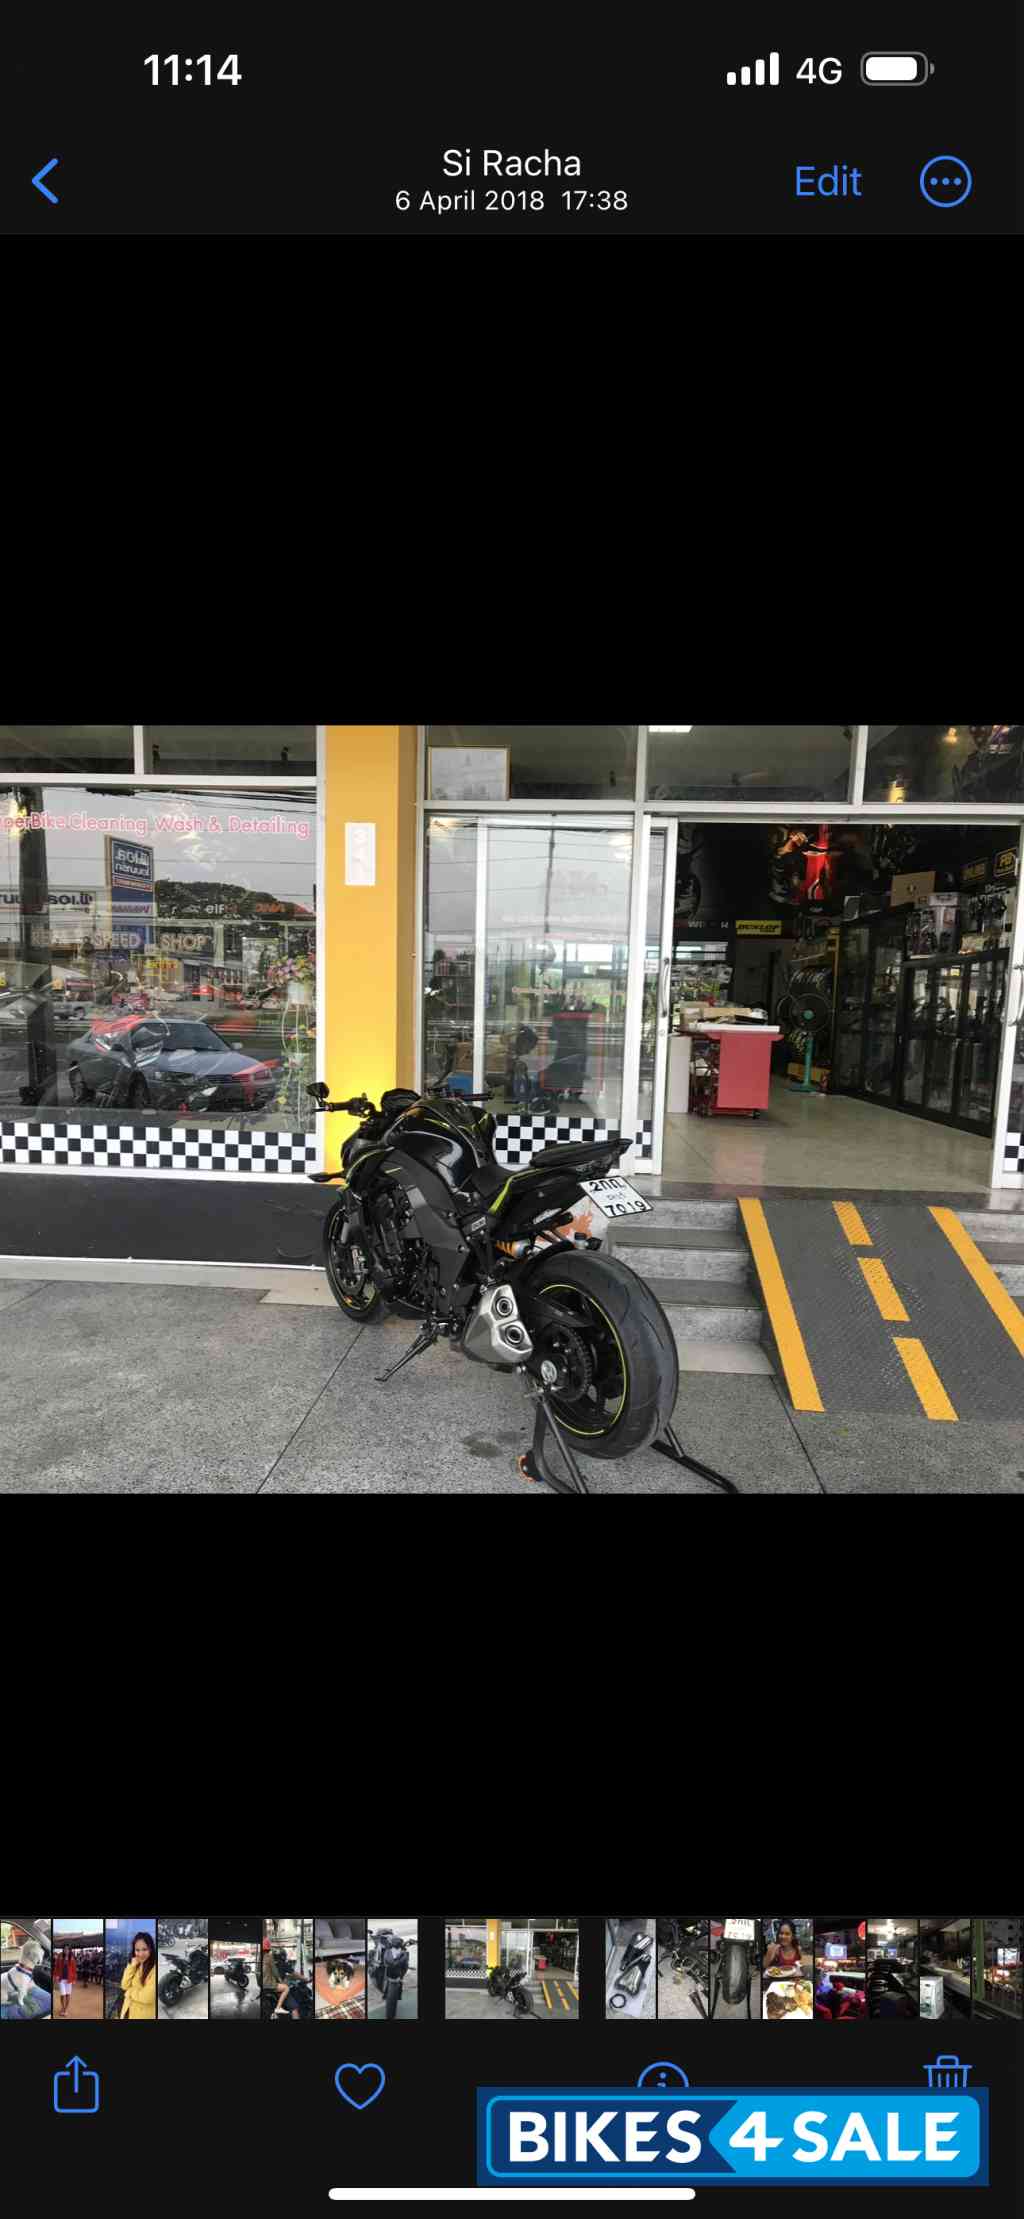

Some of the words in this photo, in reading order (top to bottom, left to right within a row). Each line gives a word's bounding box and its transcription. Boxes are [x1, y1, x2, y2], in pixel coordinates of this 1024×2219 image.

[143, 53, 243, 86] 11:14
[795, 56, 843, 85] 4G
[442, 148, 471, 177] Si
[483, 148, 581, 177] Racha
[795, 163, 863, 197] Edit
[395, 189, 411, 211] 6
[418, 189, 476, 216] April
[484, 189, 545, 211] 2018
[561, 190, 628, 211] 17:38
[154, 813, 202, 832] Wash
[208, 816, 222, 833] &
[228, 815, 309, 839] Detailing
[95, 932, 142, 949] SPEED
[160, 933, 207, 951] SHOP
[604, 1200, 647, 1216] 7019
